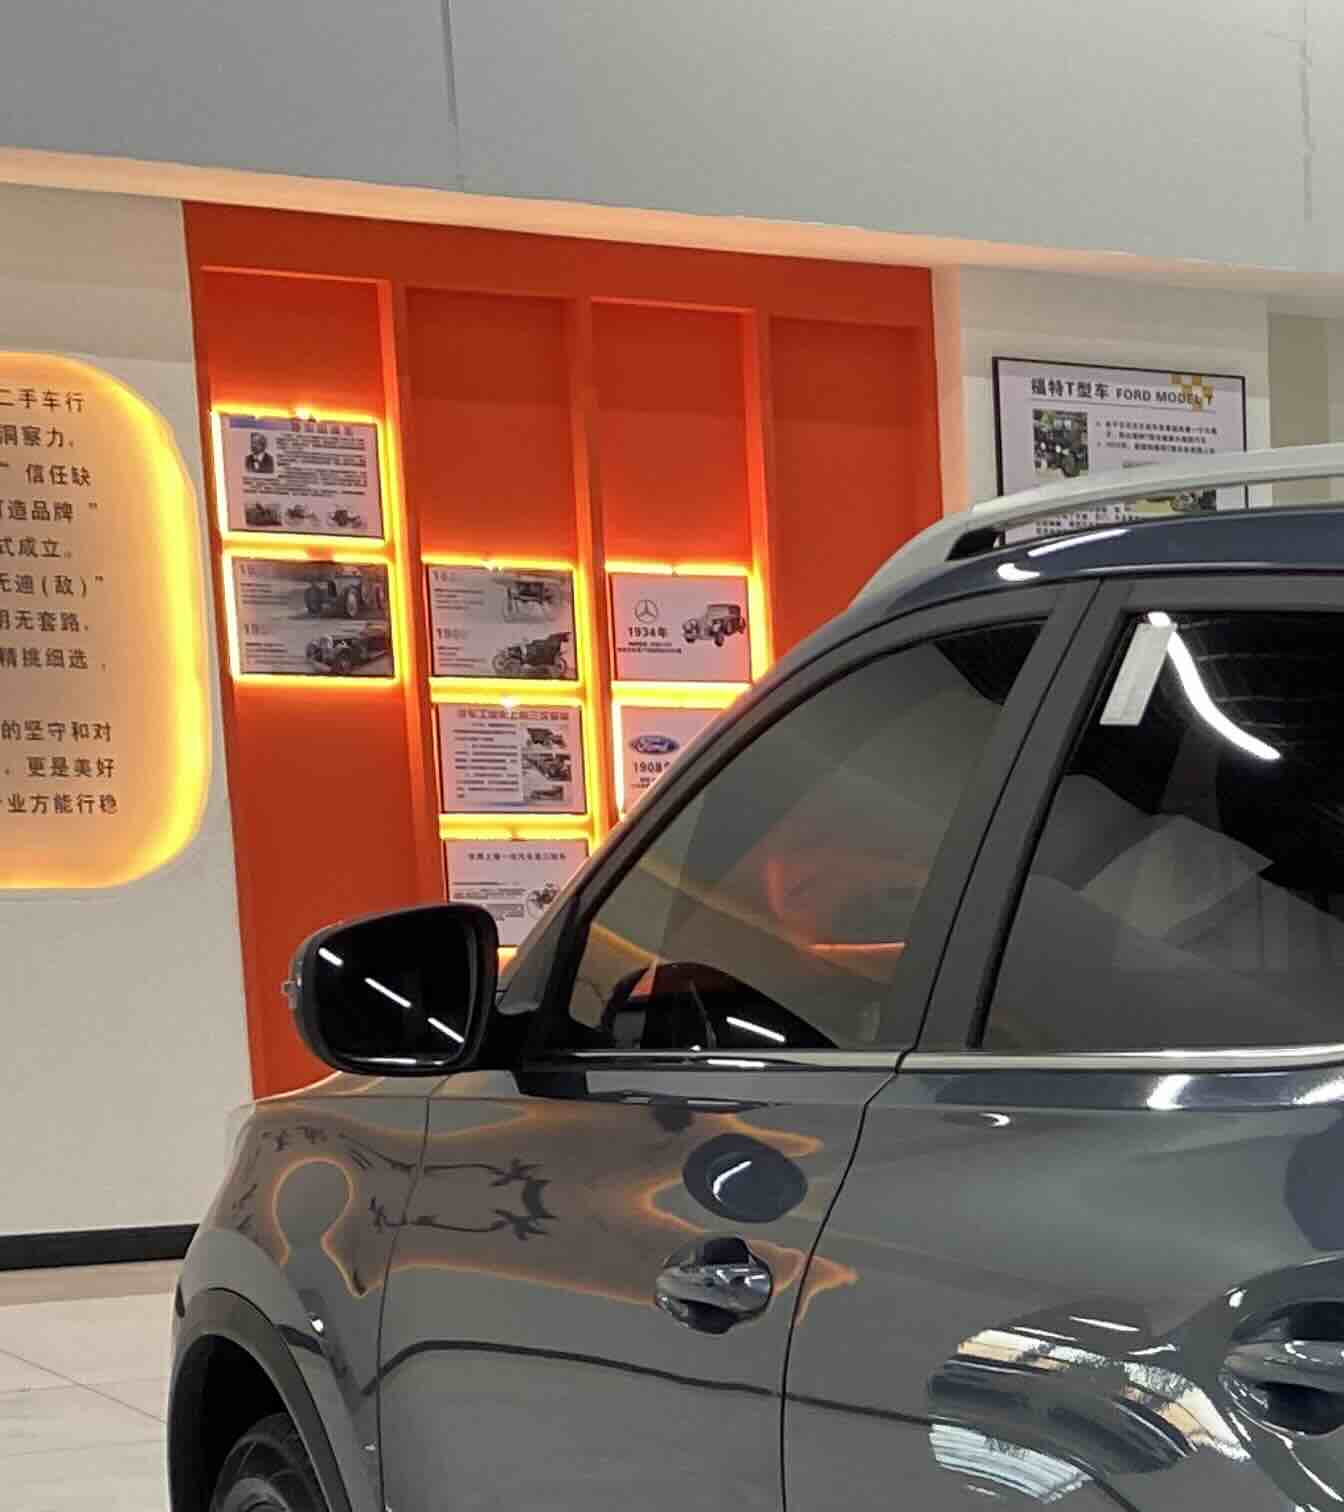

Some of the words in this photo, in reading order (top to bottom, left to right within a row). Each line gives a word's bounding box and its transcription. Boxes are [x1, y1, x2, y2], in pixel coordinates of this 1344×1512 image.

[1115, 387, 1152, 402] FORD
[0, 791, 119, 816] 业方能行稳
